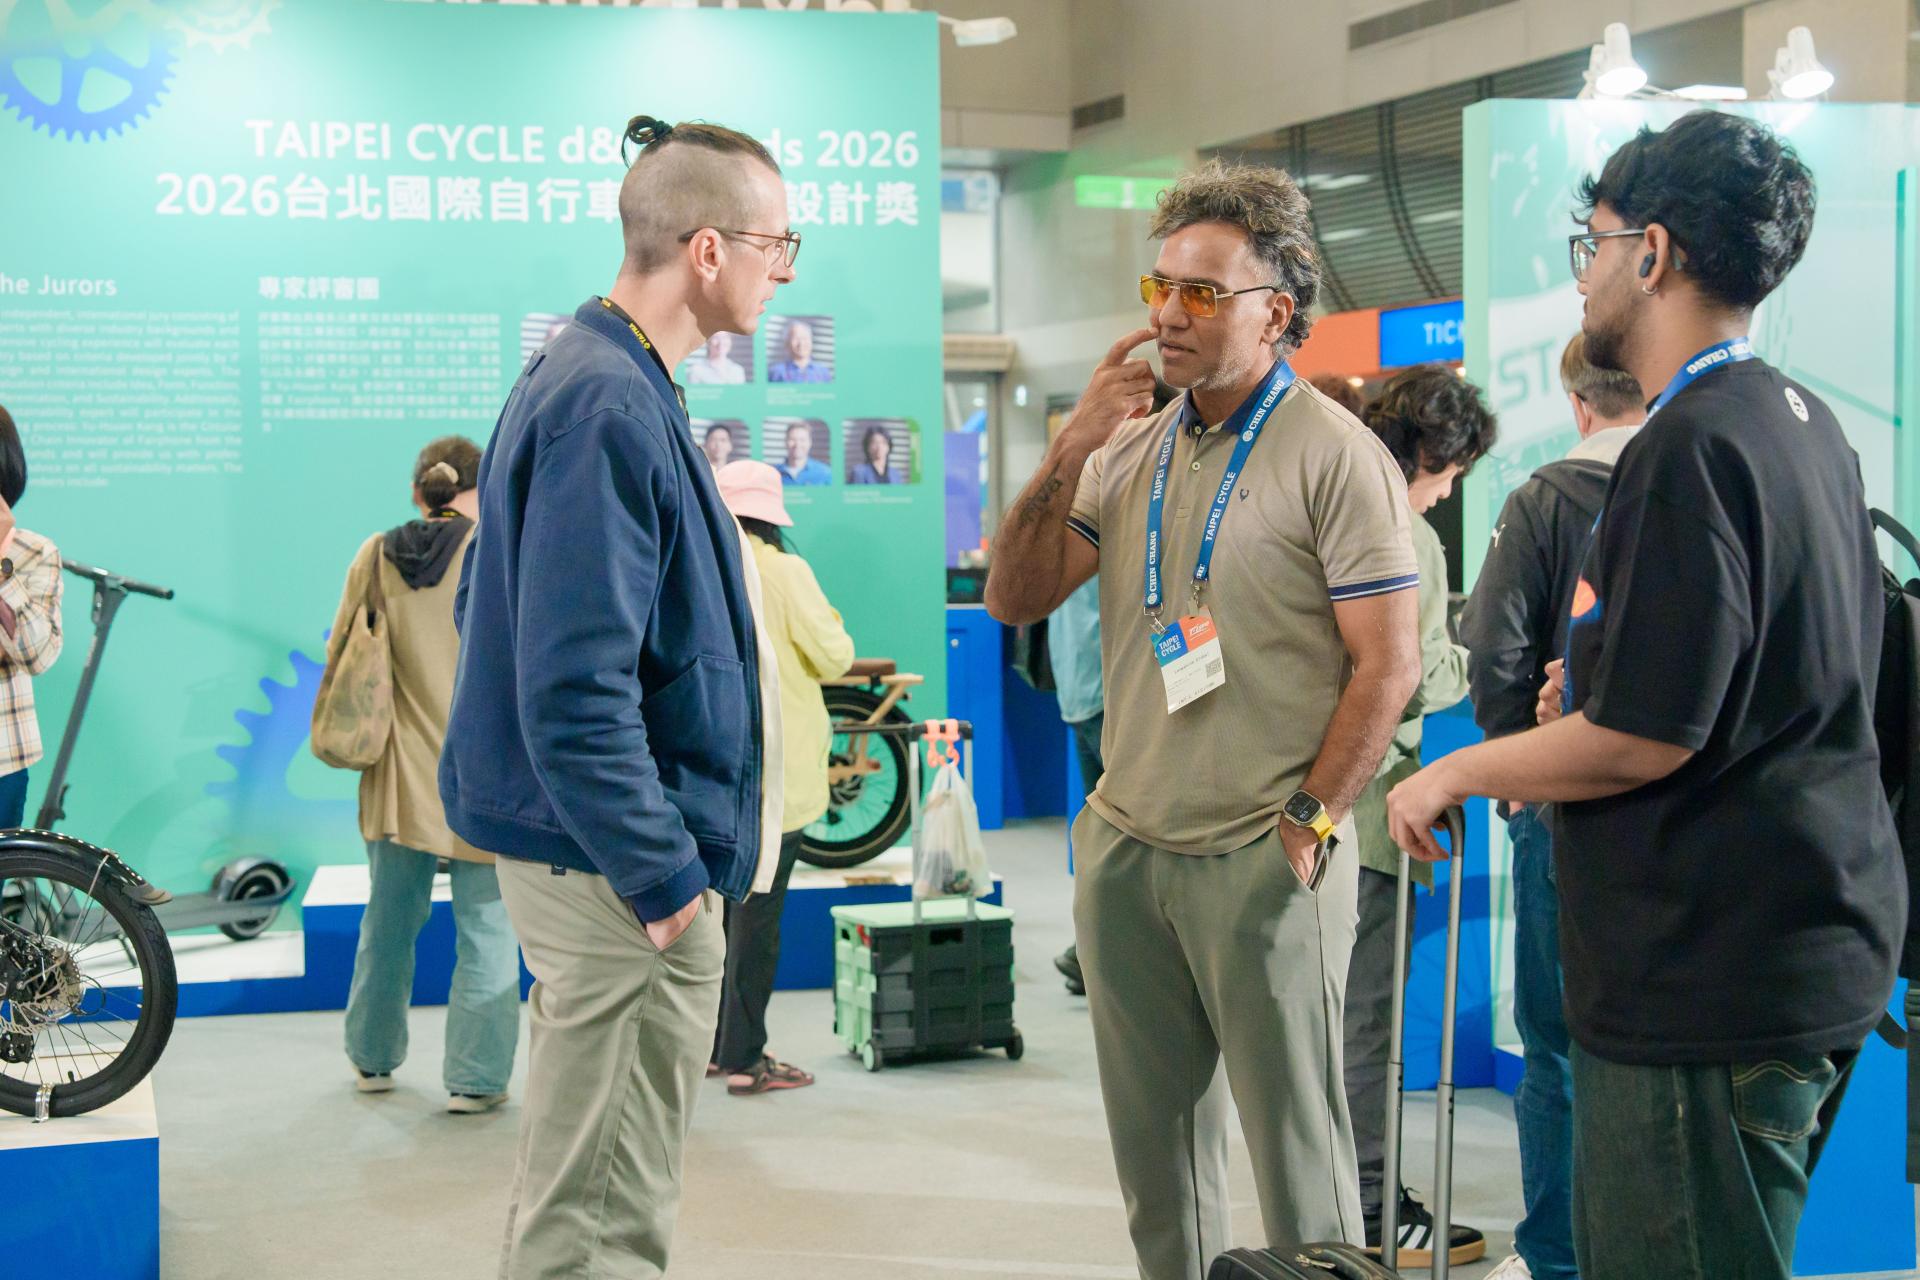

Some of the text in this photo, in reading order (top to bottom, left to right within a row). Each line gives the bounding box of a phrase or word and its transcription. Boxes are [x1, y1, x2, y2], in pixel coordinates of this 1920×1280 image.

[245, 119, 391, 160] TAIPEI
[407, 123, 544, 164] CYCLE
[816, 130, 919, 168] 2026
[37, 273, 118, 296] Jurors
[1248, 379, 1286, 430] CHIN CHANG
[1153, 435, 1173, 501] TAIPEI CYCLE
[1205, 471, 1236, 542] TAIPEI CYCLE
[1149, 530, 1157, 592] CHIN CHANG
[1158, 634, 1179, 650] TAIPEI
[1161, 641, 1182, 658] CYCLE
